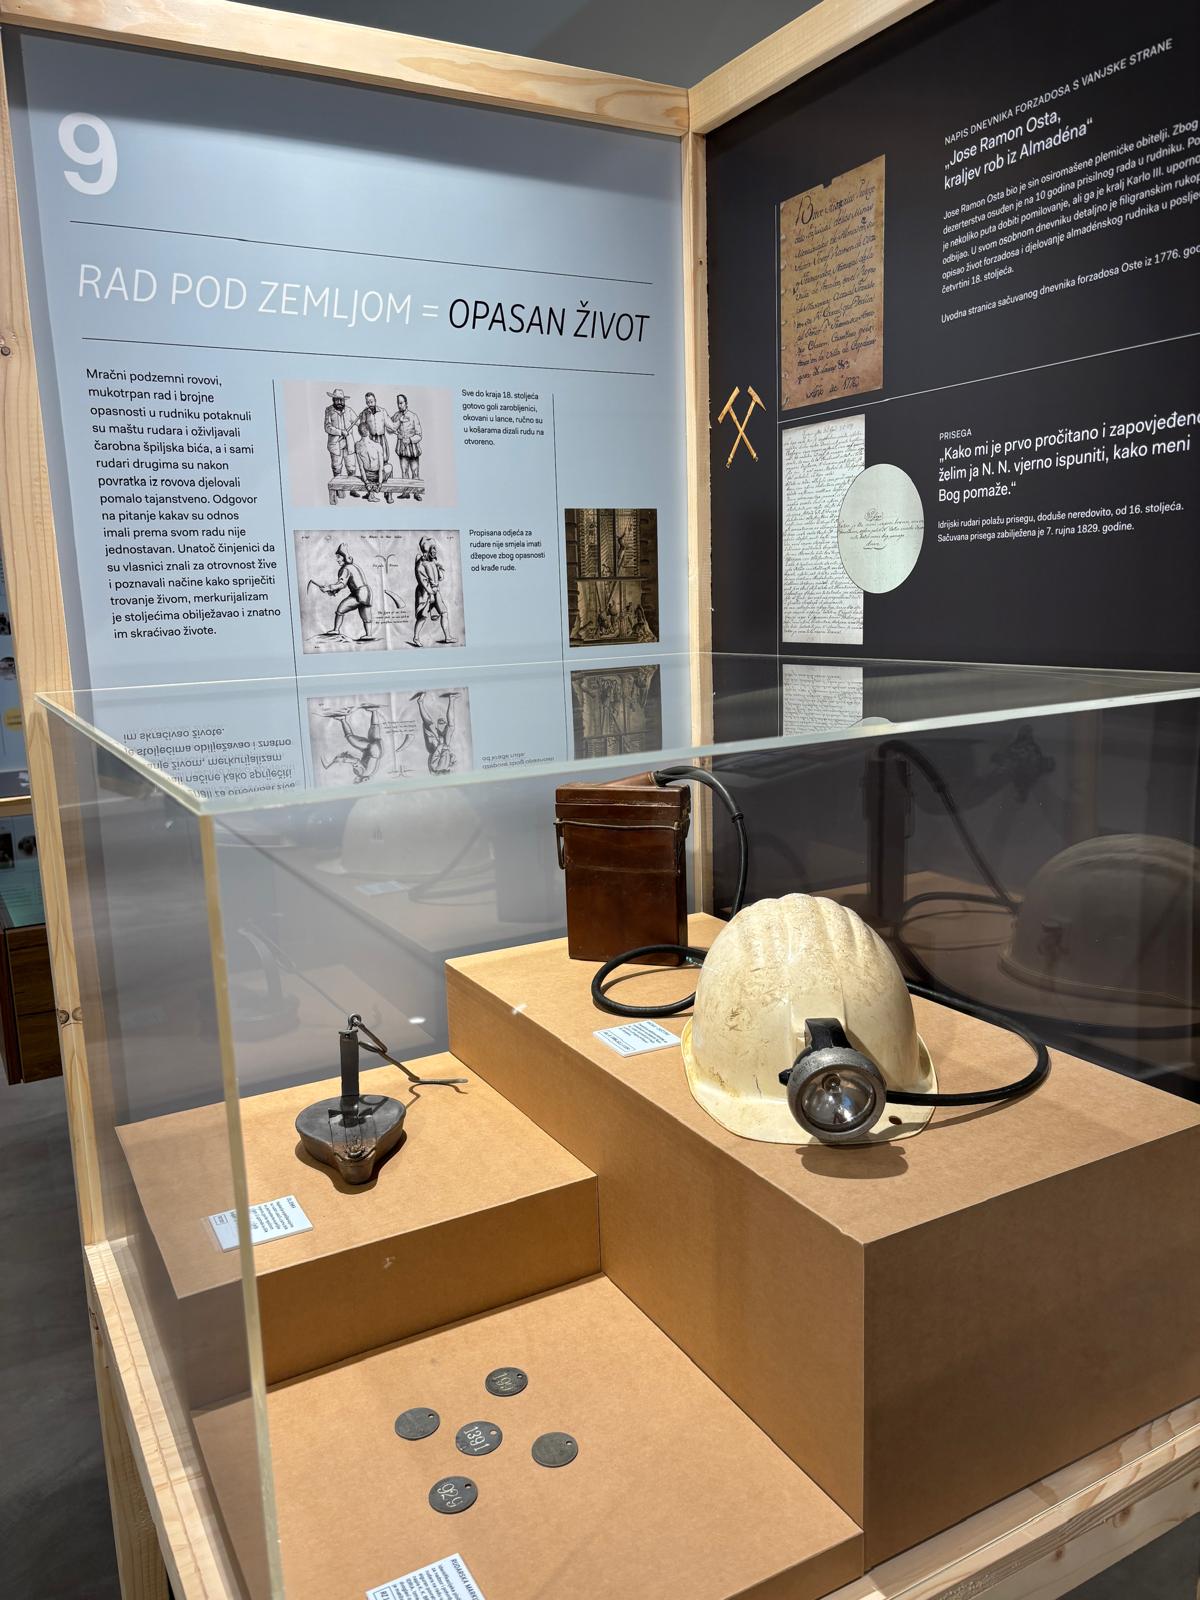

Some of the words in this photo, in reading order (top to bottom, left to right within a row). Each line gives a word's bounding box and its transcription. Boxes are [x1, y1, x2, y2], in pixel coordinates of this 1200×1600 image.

[944, 128, 968, 145] NAPIS
[970, 109, 1013, 134] DNEVNIKA
[1015, 84, 1070, 115] FORZADOSA
[1073, 79, 1079, 90] S
[1082, 58, 1126, 86] VANJSKE
[1130, 38, 1172, 65] STRANE
[945, 145, 977, 170] „Jose
[980, 126, 1022, 152] Ramon
[1026, 111, 1060, 132] Osta,
[57, 111, 118, 195] 9
[944, 166, 981, 190] kraljev
[984, 154, 1004, 174] rob
[1007, 149, 1016, 165] iz
[1020, 117, 1093, 159] Almadéna“
[943, 208, 959, 220] Jose
[960, 198, 985, 213] Ramon
[986, 191, 1004, 203] Osta
[1006, 185, 1018, 196] bio
[1019, 182, 1026, 194] je
[1028, 177, 1039, 188] sin
[1040, 158, 1093, 183] osiromašene
[1094, 143, 1134, 166] plemićke
[1136, 130, 1170, 148] obitelji.
[1172, 120, 1198, 136] Zbog
[79, 264, 157, 302] RAD
[171, 272, 246, 309] POD
[258, 281, 411, 327] ZEMLJOM
[422, 305, 438, 317] =
[449, 298, 565, 336] OPASAN
[573, 300, 650, 342] ŽIVOT
[86, 368, 126, 380] Mračni
[130, 371, 184, 383] podzemni
[187, 375, 222, 387] rovovi,
[88, 387, 150, 401] mukotrpan
[154, 390, 171, 400] rad
[174, 390, 177, 400] i
[180, 390, 214, 404] brojne
[90, 407, 146, 418] opasnosti
[159, 408, 200, 419] rudniku
[203, 410, 251, 422] potaknuli
[109, 423, 144, 434] maštu
[147, 425, 182, 435] rudara
[185, 426, 188, 436] i
[191, 426, 240, 439] oživljavali
[939, 428, 972, 440] PRISEGA
[94, 440, 140, 451] čarobna
[143, 442, 184, 454] špiljska
[186, 442, 212, 454] bića,
[224, 443, 226, 453] i
[229, 444, 254, 454] sami
[940, 445, 972, 463] „Kako
[974, 441, 988, 456] mi
[991, 440, 1001, 458] je
[1004, 438, 1032, 456] prvo
[1035, 428, 1098, 451] pročitano
[1102, 422, 1105, 438] i
[96, 457, 130, 468] rudari
[132, 458, 178, 471] drugima
[197, 460, 229, 470] nakon
[938, 466, 966, 481] želim
[969, 464, 978, 481] ja
[982, 462, 994, 476] N.
[998, 460, 1010, 474] N.
[1014, 457, 1052, 475] vjerno
[1056, 446, 1108, 469] ispuniti,
[1114, 442, 1148, 459] kako
[1152, 434, 1191, 455] meni
[98, 475, 146, 488] povratka
[149, 476, 158, 486] iz
[160, 479, 195, 487] rovova
[198, 477, 240, 489] djelovali
[100, 493, 142, 506] pomalo
[144, 493, 210, 506] tajanstveno.
[212, 494, 258, 506] Odgovor
[939, 488, 960, 503] Bog
[963, 481, 1016, 502] pomaže.“
[118, 510, 156, 523] pitanje
[158, 510, 189, 520] kakav
[206, 510, 239, 520] odnos
[938, 520, 959, 530] Idrijski
[960, 518, 980, 527] rudari
[982, 516, 1004, 527] polažu
[1006, 515, 1035, 525] prisegu,
[1037, 511, 1066, 521] doduše
[1068, 507, 1113, 518] neredovito,
[1115, 505, 1127, 515] od
[1129, 504, 1142, 514] 16.
[1145, 501, 1184, 514] stoljeća.
[103, 527, 130, 537] imali
[133, 530, 168, 539] prema
[170, 529, 199, 537] svom
[202, 527, 225, 536] radu
[228, 526, 246, 538] nije
[469, 529, 501, 537] Propisana
[503, 529, 523, 537] odjeća
[938, 533, 968, 542] Sačuvana
[970, 532, 995, 542] prisega
[997, 528, 1036, 539] zabilježena
[1037, 527, 1044, 538] je
[1046, 526, 1053, 535] 7.
[1055, 525, 1075, 536] rujna
[1077, 523, 1100, 534] 1829.
[1102, 521, 1134, 534] godine.
[105, 544, 175, 556] jednostavan.
[178, 543, 216, 553] Unatoč
[218, 542, 260, 555] činjenici
[262, 542, 275, 552] da
[492, 541, 503, 549] nije
[122, 560, 163, 571] vlasnici
[166, 561, 190, 571] znali
[206, 561, 256, 570] otrovnost
[258, 558, 276, 569] žive
[108, 579, 112, 588] i
[115, 577, 165, 591] poznavali
[168, 577, 203, 587] načine
[205, 576, 230, 586] kako
[232, 575, 275, 587] spriječiti
[110, 594, 154, 606] trovanje
[156, 594, 190, 604] živom,
[194, 592, 268, 604] merkurijalizam
[112, 612, 122, 624] je
[124, 610, 180, 623] stoljećima
[182, 608, 239, 621] obilježavao
[242, 607, 244, 617] i
[247, 608, 280, 617] znatno
[114, 629, 128, 638] im
[130, 627, 181, 638] skraćivao
[183, 626, 216, 635] živote.
[463, 1426, 490, 1452] 1391
